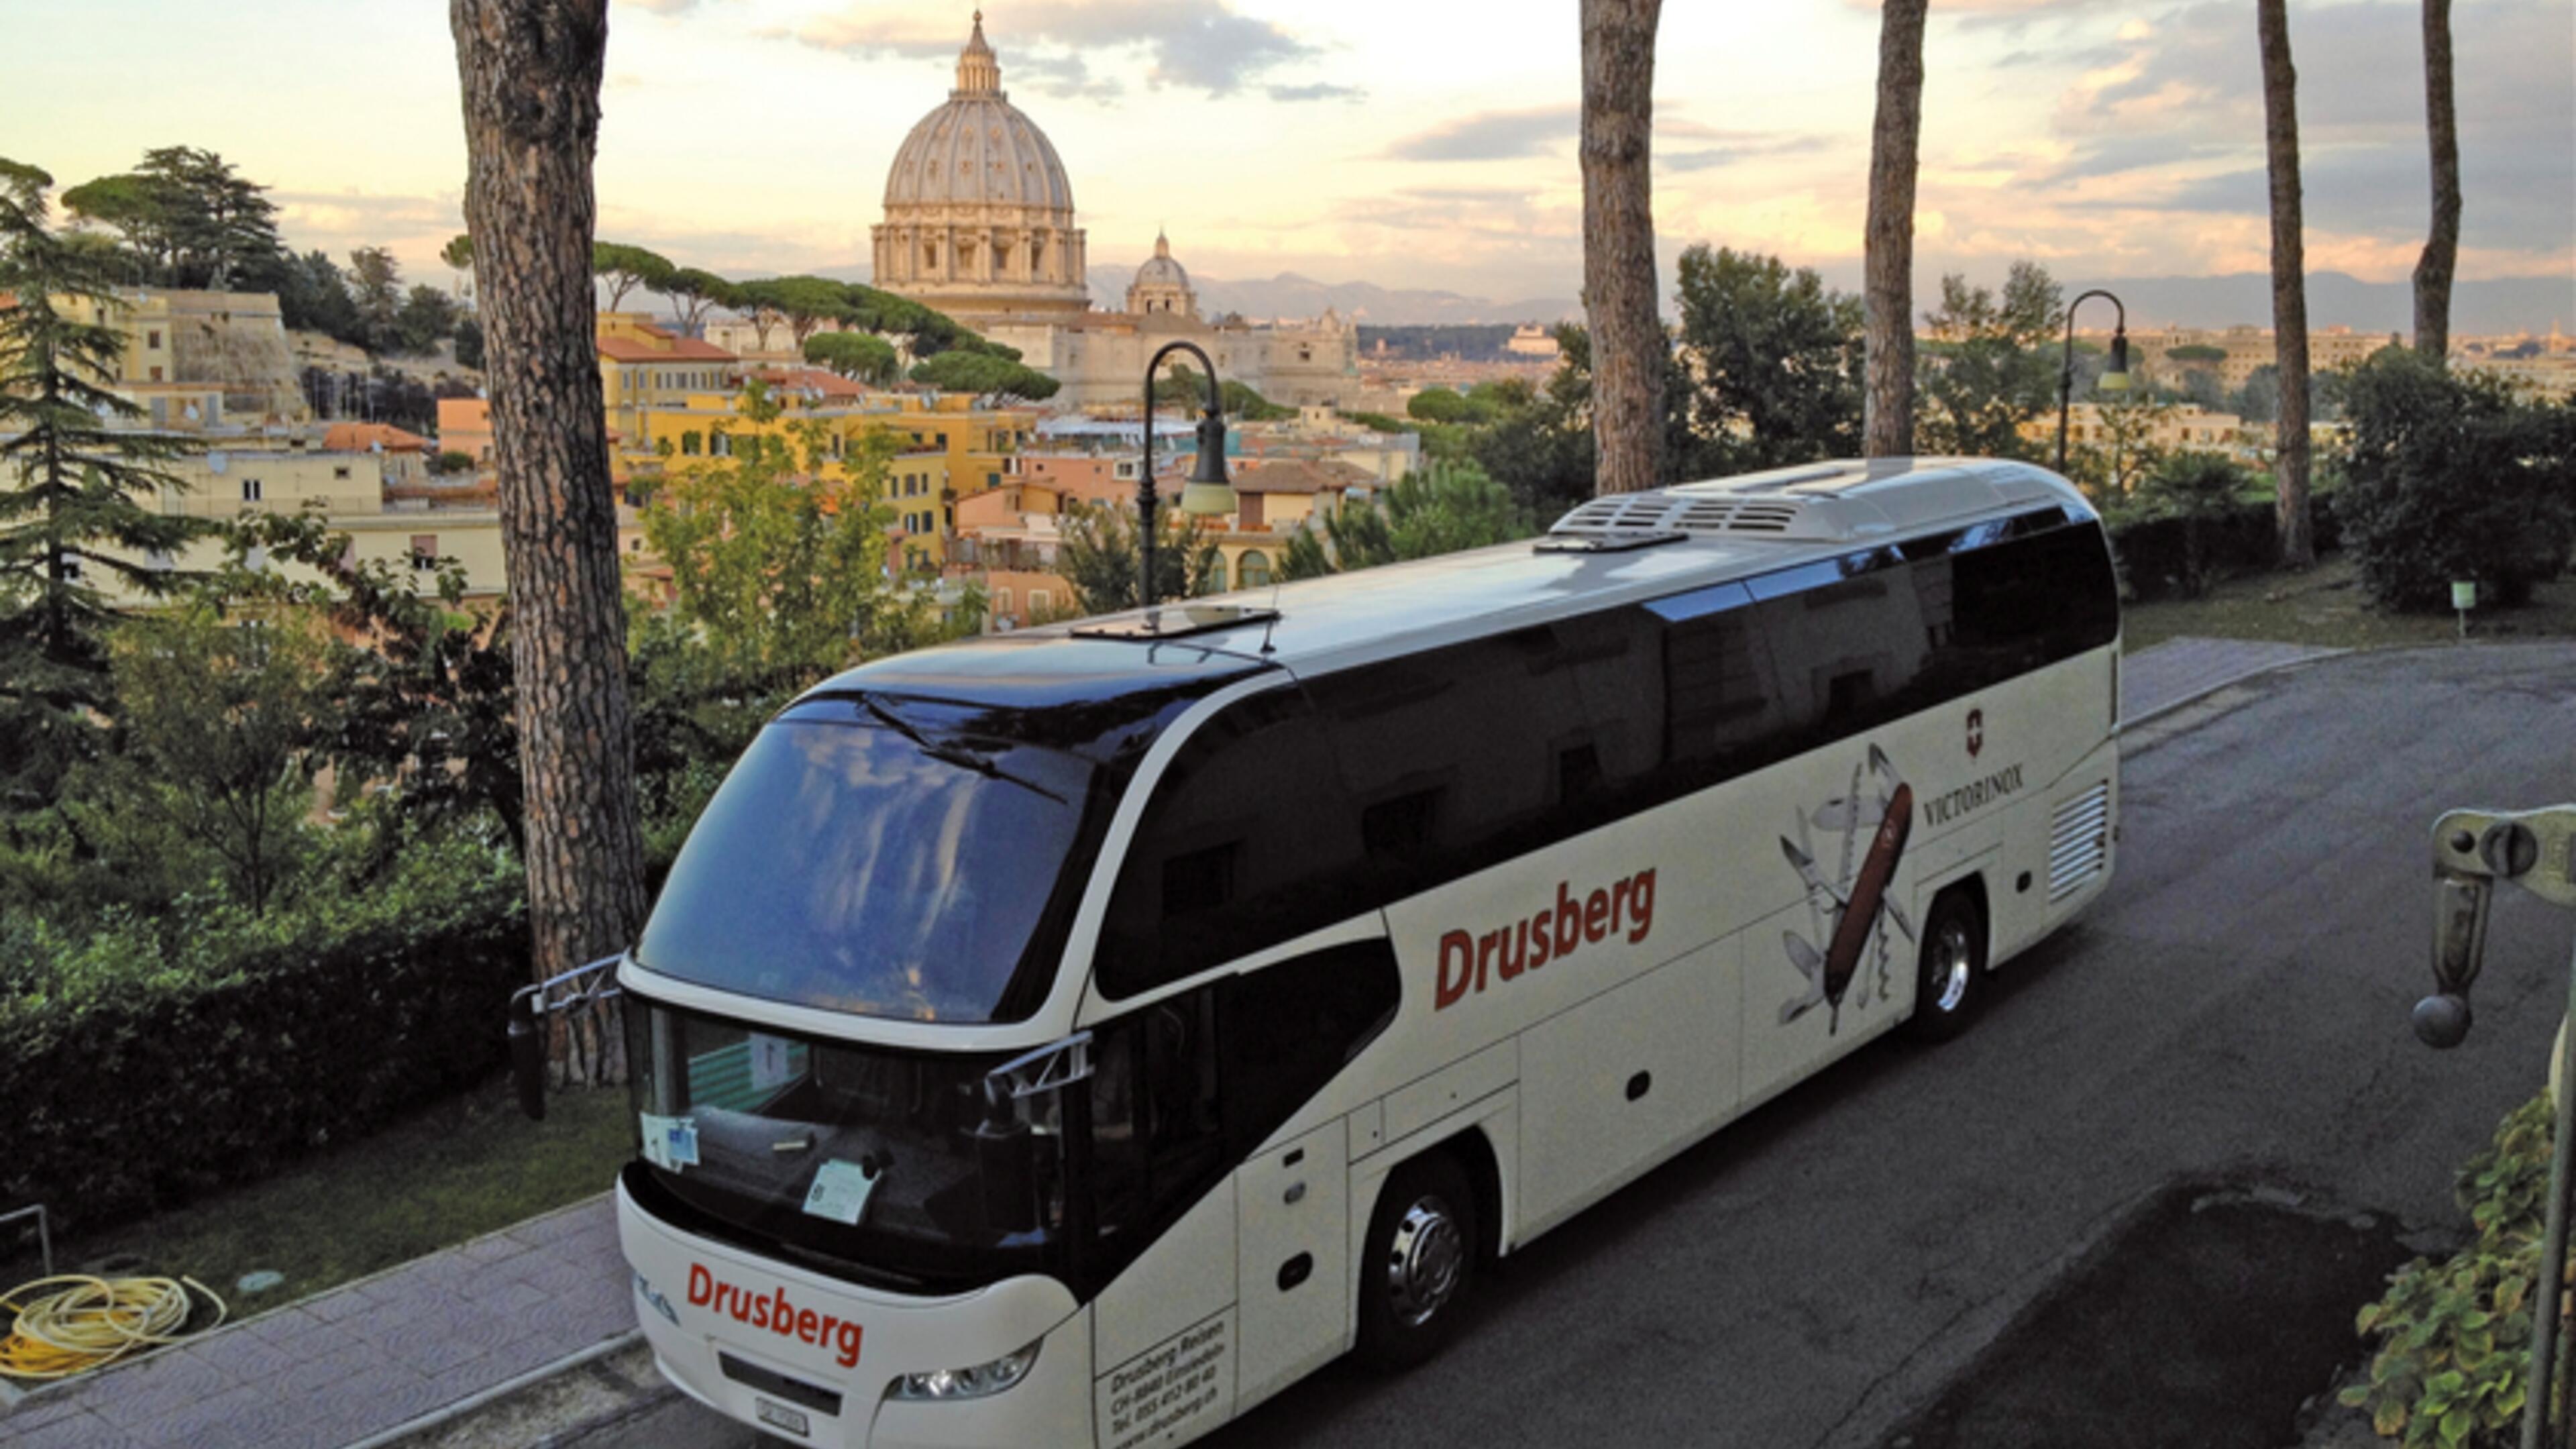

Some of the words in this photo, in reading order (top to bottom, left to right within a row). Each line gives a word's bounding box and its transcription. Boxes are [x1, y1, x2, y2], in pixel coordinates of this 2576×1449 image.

[1923, 763, 2023, 826] VICTORINOX
[1434, 867, 1656, 1012] Drusberg
[688, 1262, 863, 1368] Drusberg
[1111, 1346, 1176, 1395] Drusberg
[1181, 1321, 1224, 1353] Reisen
